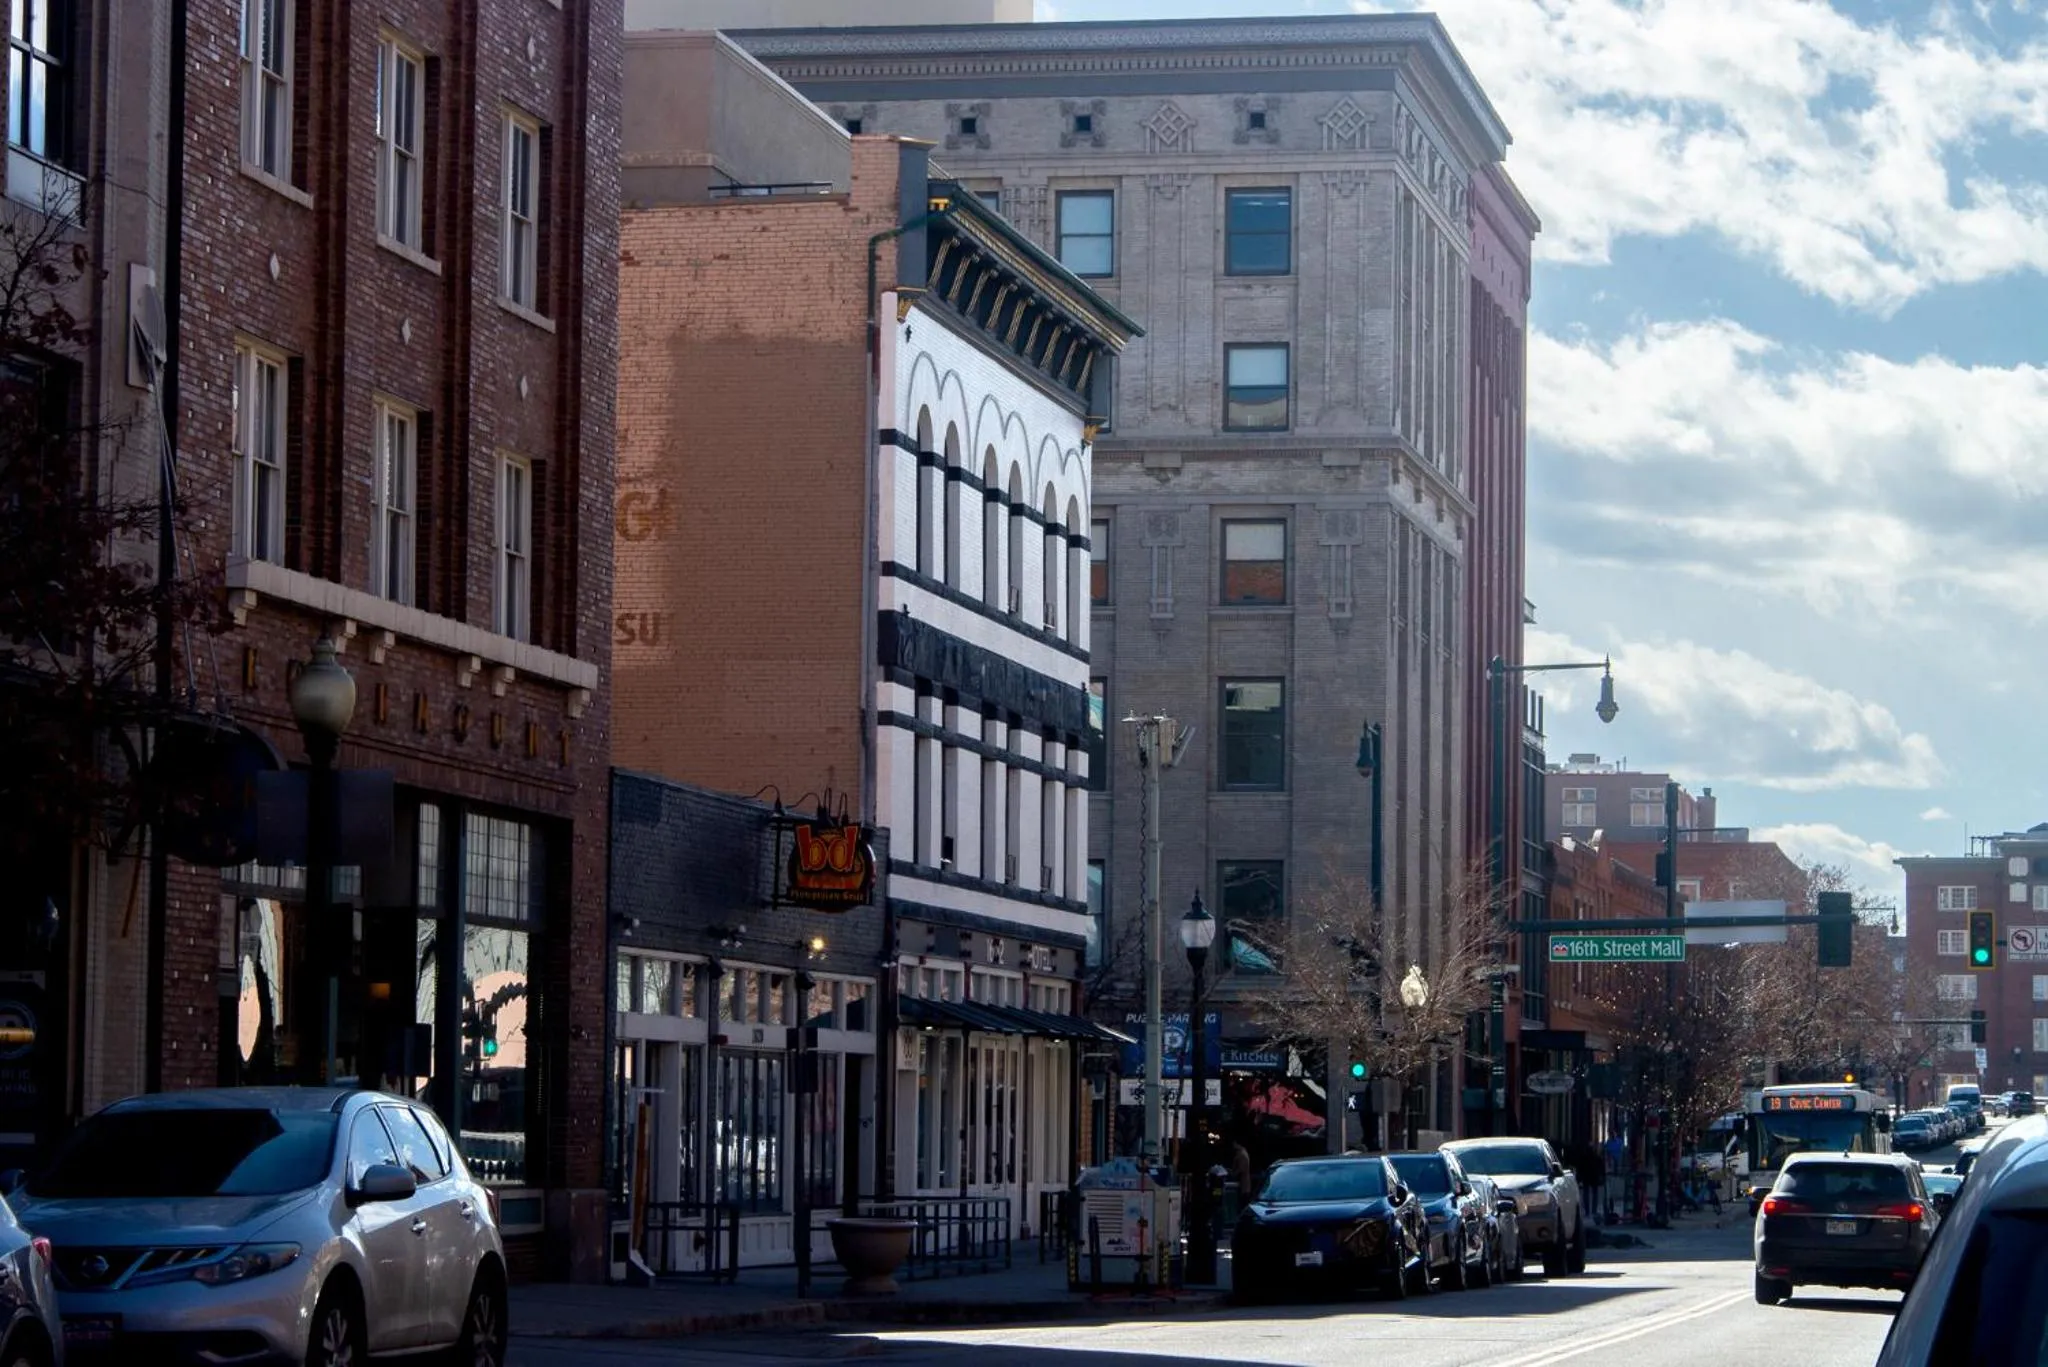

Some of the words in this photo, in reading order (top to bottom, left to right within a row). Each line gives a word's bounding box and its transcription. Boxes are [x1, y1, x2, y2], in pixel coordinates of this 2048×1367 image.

[1569, 940, 1598, 957] 16th
[1603, 940, 1647, 957] Street
[1651, 939, 1681, 957] Mall
[1771, 1097, 1781, 1110] 19
